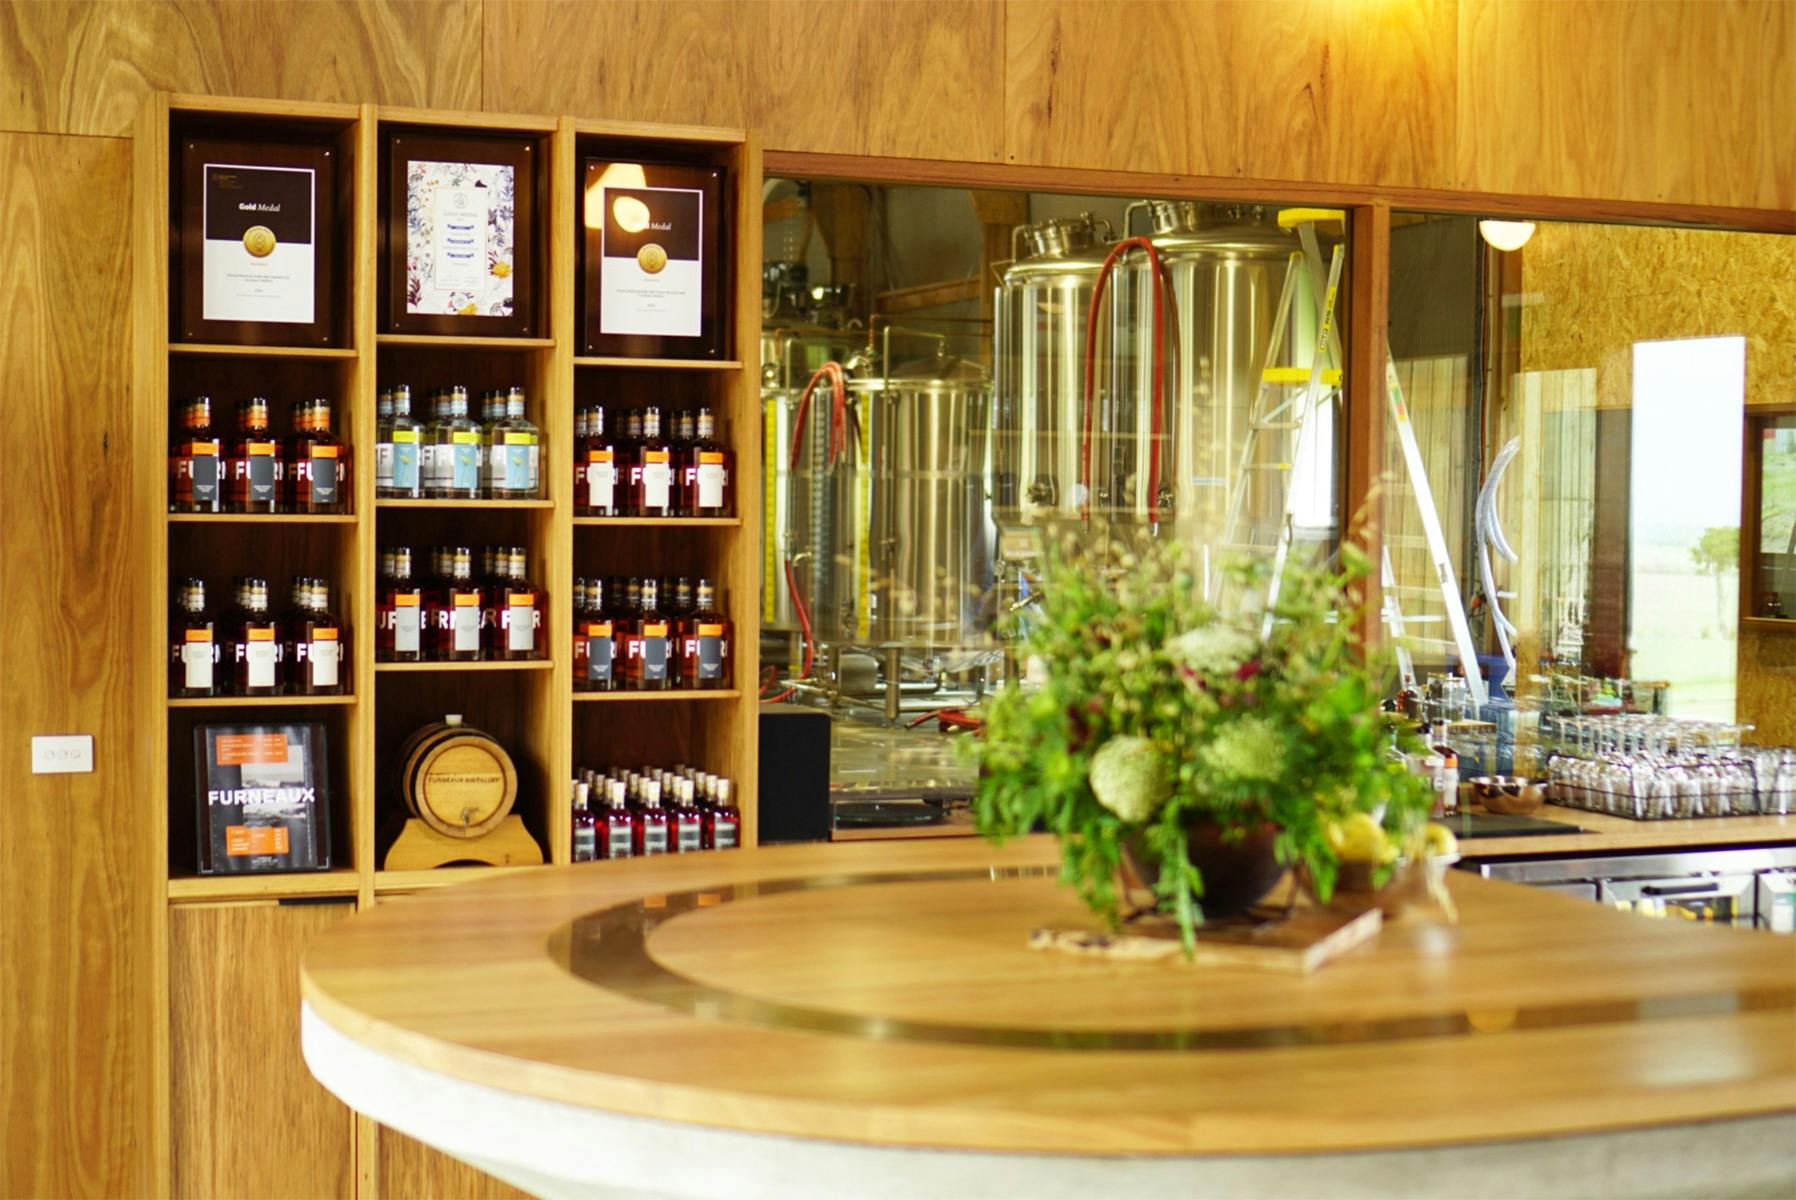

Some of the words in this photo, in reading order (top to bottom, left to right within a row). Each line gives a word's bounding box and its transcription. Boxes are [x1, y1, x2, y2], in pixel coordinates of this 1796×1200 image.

[238, 202, 257, 211] Gold
[257, 203, 281, 213] Medal
[650, 221, 673, 231] Medal
[207, 787, 316, 806] FURNEAUX
